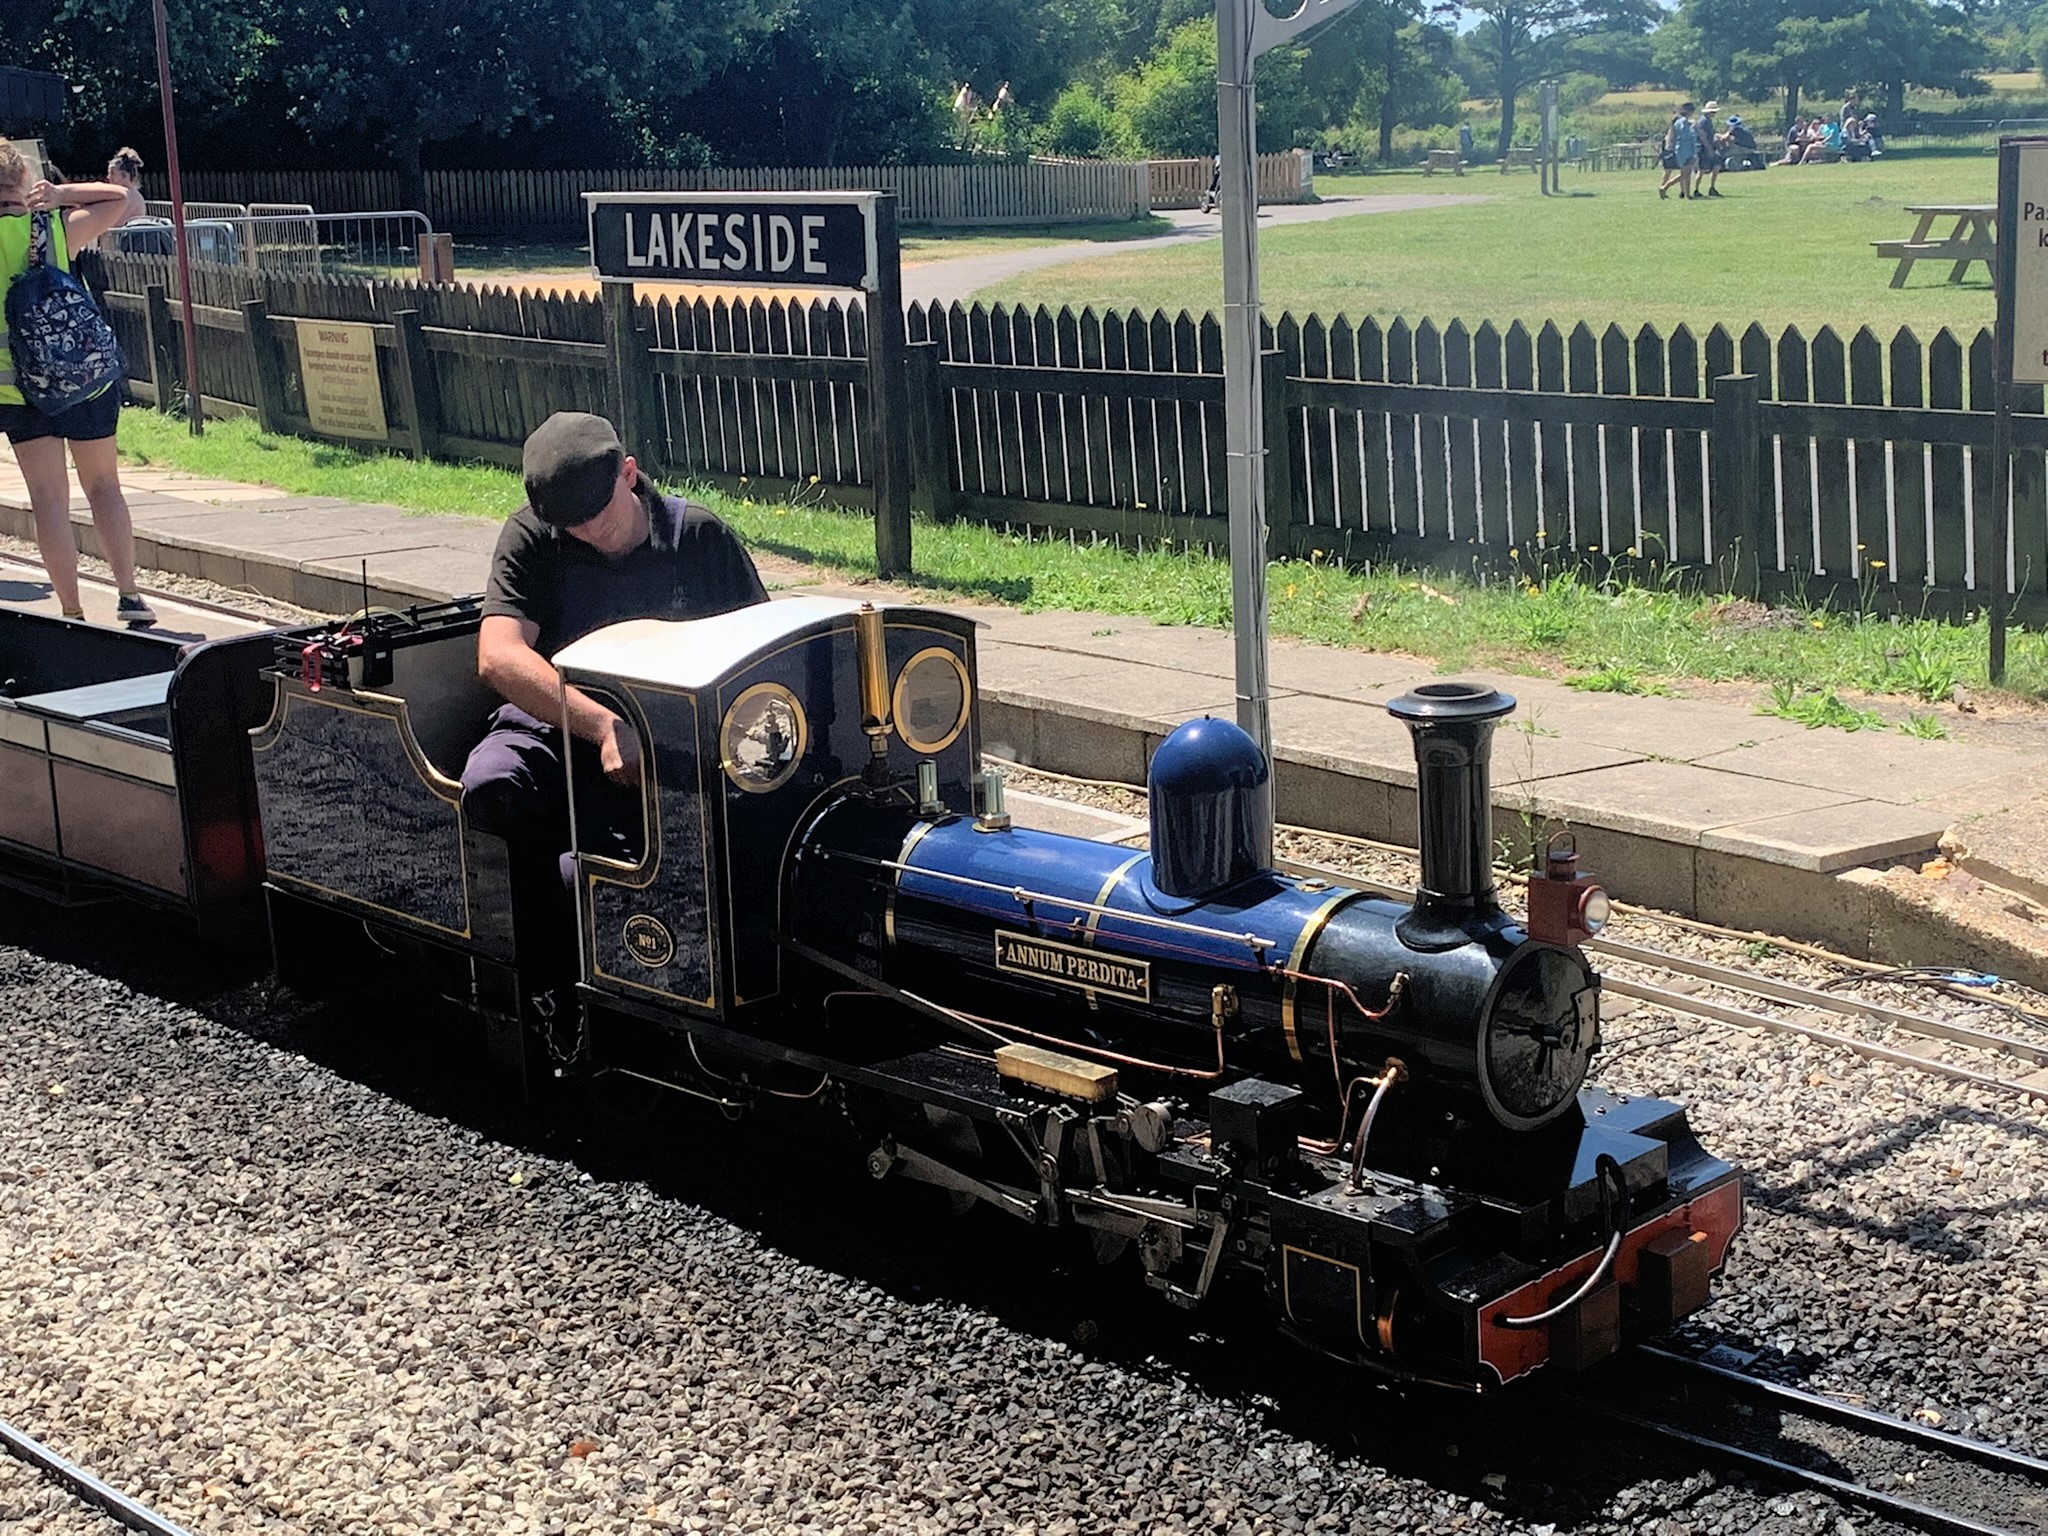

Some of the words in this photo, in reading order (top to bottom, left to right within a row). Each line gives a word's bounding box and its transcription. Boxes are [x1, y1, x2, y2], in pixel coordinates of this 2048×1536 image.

[625, 212, 828, 275] LAKESIDE
[318, 330, 349, 344] WARNING
[1006, 942, 1064, 974] ANNUM
[1066, 955, 1138, 990] PERDITA
